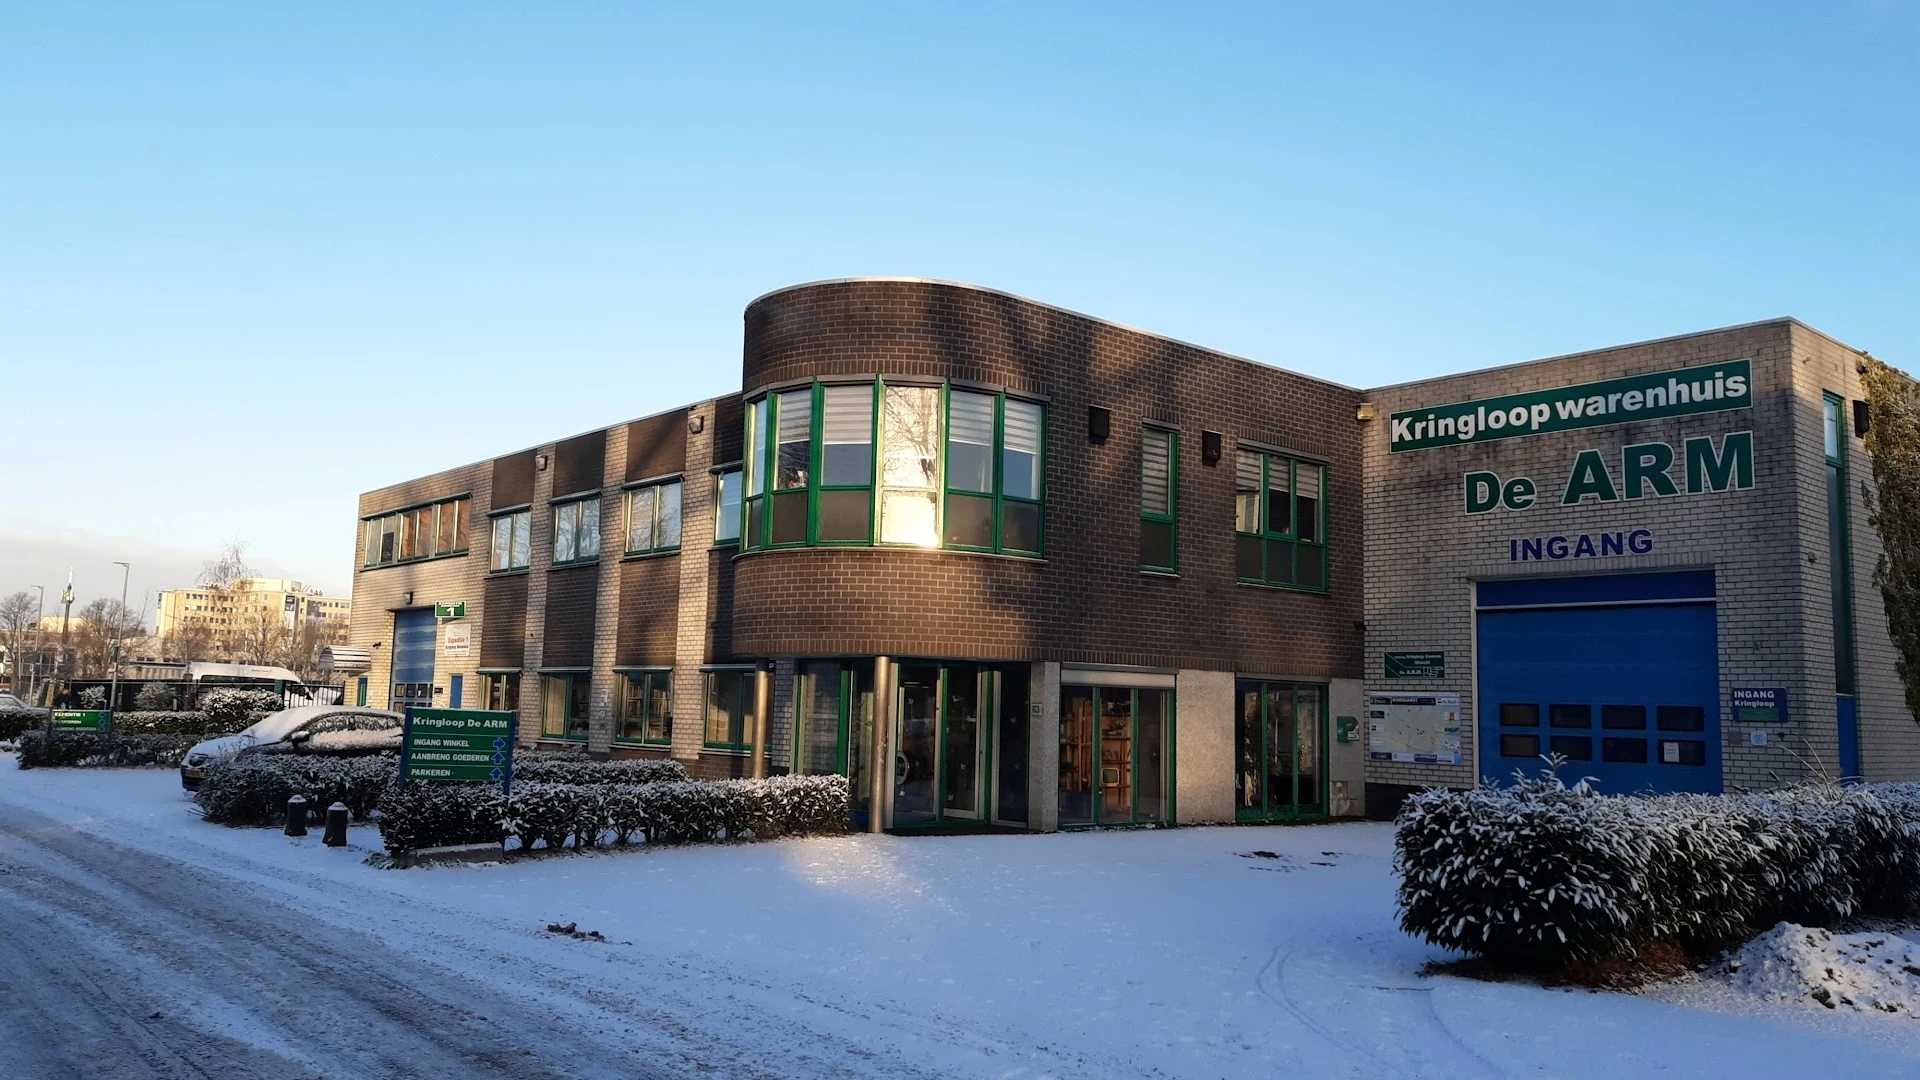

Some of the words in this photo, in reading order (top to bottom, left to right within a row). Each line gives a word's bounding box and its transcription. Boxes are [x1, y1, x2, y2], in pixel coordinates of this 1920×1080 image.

[1391, 402, 1551, 442] Kringloop
[1555, 371, 1747, 421] warenhuis
[1464, 470, 1537, 516] De
[1560, 430, 1756, 506] ARM
[1509, 528, 1654, 562] INGANG
[1734, 690, 1775, 698] INGANG
[1734, 700, 1775, 708] Kringloop
[413, 717, 465, 728] Kringloop
[467, 719, 481, 727] De
[483, 720, 508, 728] ARM
[413, 739, 441, 747] INGANG
[443, 739, 470, 747] WINKEL
[452, 753, 489, 761] GOEDEREN
[411, 768, 451, 776] PARKEREN
